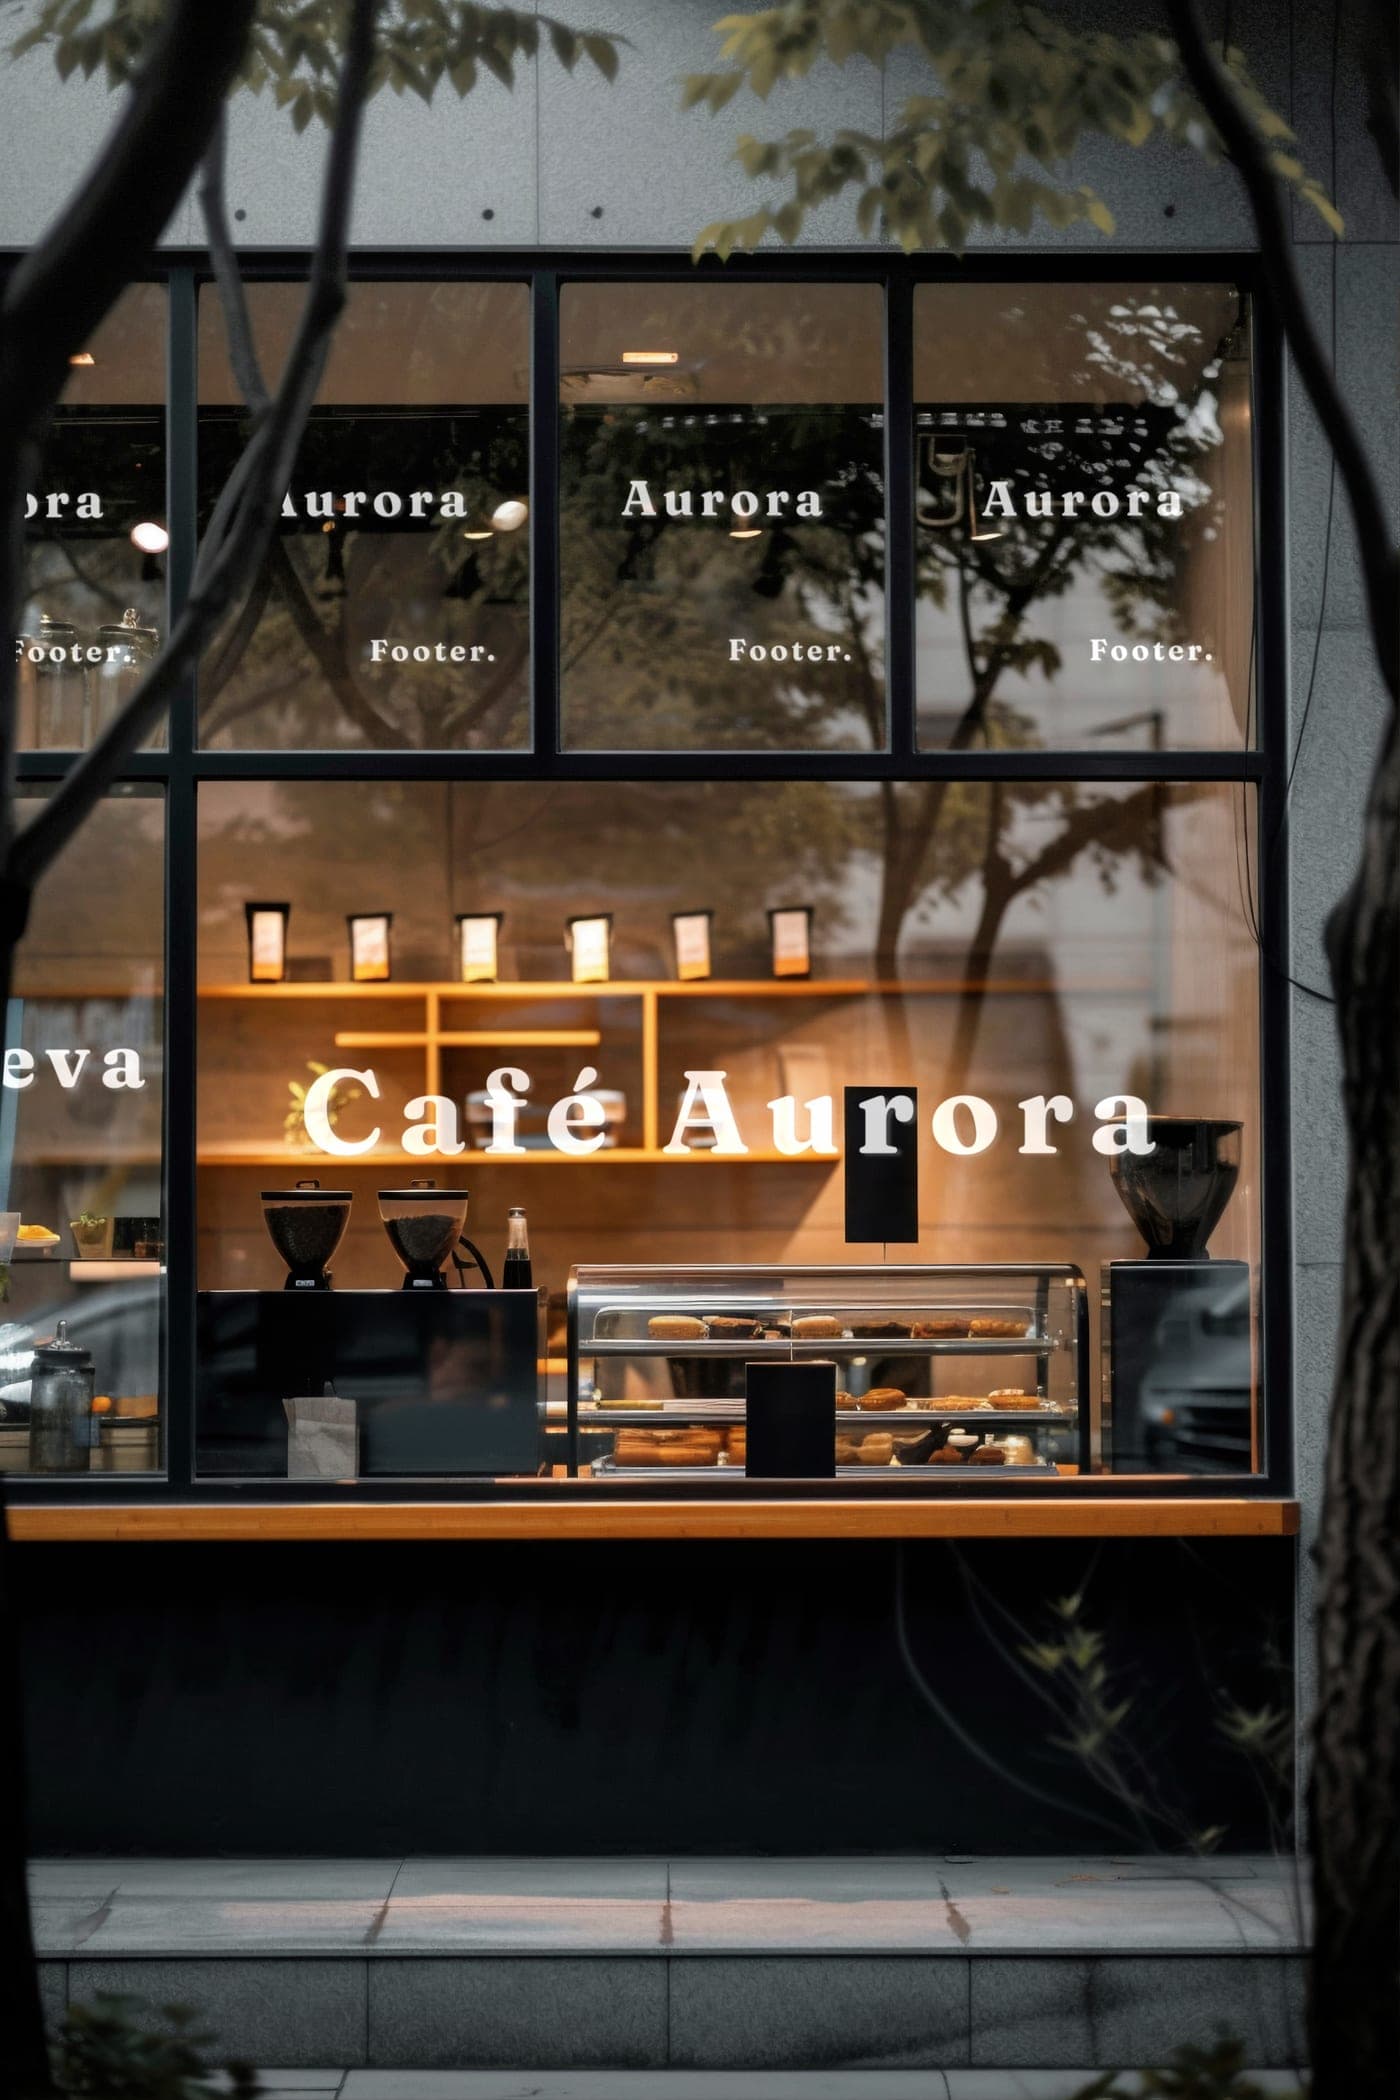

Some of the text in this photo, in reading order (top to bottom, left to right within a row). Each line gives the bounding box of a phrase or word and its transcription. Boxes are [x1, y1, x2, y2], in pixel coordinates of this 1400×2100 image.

[621, 480, 824, 518] Aurora
[982, 480, 1184, 518] Aurora
[15, 639, 132, 663] ooter.
[370, 638, 495, 662] Footer.
[729, 638, 852, 662] Footer.
[1089, 638, 1213, 662] Footer.
[303, 1066, 1157, 1157] Café Aurora
